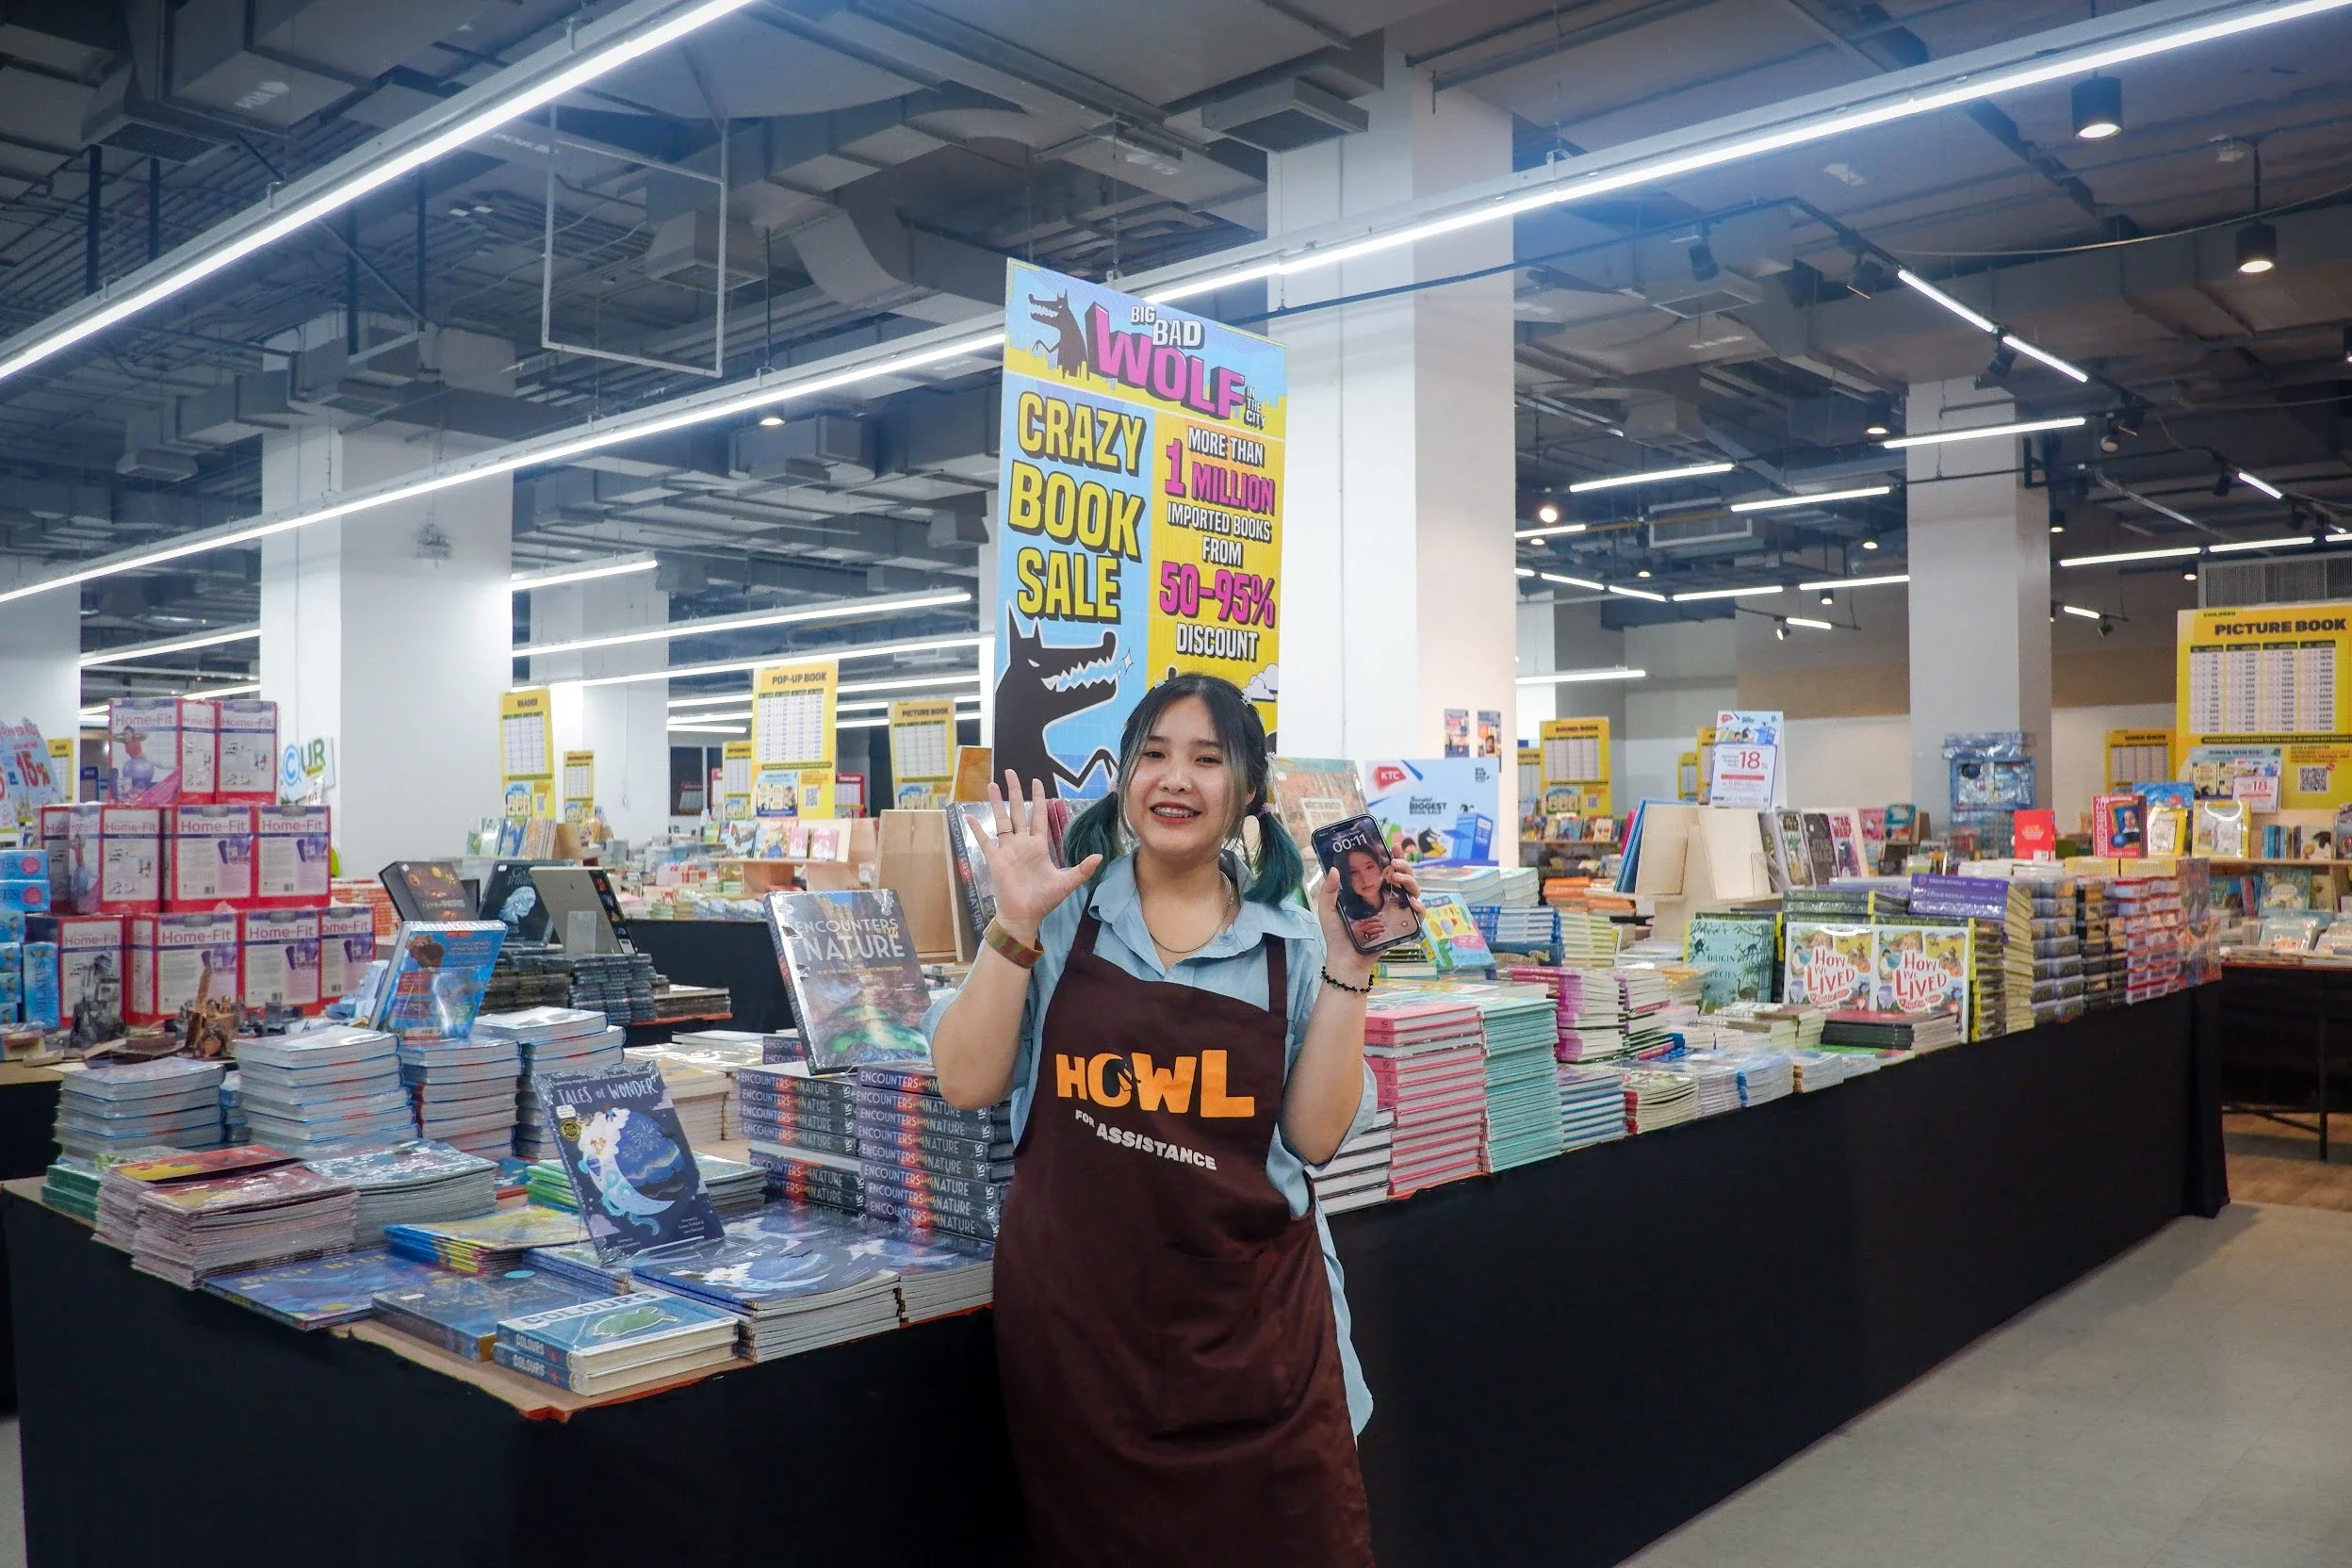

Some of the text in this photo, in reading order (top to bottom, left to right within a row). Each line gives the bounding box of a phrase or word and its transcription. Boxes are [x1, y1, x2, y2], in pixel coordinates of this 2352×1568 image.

[1131, 305, 1156, 325] BIG
[1153, 318, 1204, 350] BAD
[1086, 302, 1246, 420] WOLF
[1246, 384, 1255, 398] IN
[1246, 397, 1262, 413] THE
[1245, 409, 1267, 428] CITY
[1018, 390, 1148, 475] CRAZY
[1187, 426, 1265, 466] MORE THAN
[1165, 438, 1275, 516] 1 MILLION
[1007, 462, 1146, 562] BOOK
[1167, 501, 1272, 543] IMPORTED BOOKS
[1202, 537, 1243, 566] FROM
[1017, 547, 1121, 623] SALE
[1159, 561, 1275, 627] 50-95%
[2214, 618, 2346, 636] PICTURE BOOK
[1176, 623, 1259, 662] DISCOUNT
[773, 672, 826, 685] POP-UP BOOK
[115, 714, 172, 727] Home-Fit
[220, 717, 272, 728] Home-Fit
[903, 709, 930, 717] PICTURE
[1380, 771, 1401, 781] KTC
[1410, 802, 1446, 810] BIGGEST
[106, 820, 155, 831] Home-Fit
[181, 820, 245, 832] Home-Fit
[262, 819, 322, 831] Home-Fit
[1332, 833, 1368, 853] 00:11
[948, 808, 971, 876] ENCOUNTERS
[969, 889, 985, 931] NATURE
[162, 929, 231, 943] Home-Fit
[249, 924, 314, 939] Home-Fit
[321, 920, 368, 933] ome-Fit
[797, 919, 898, 934] ENCOUNTERS
[65, 934, 118, 945] Home-Fit
[803, 934, 905, 961] NATURE
[1806, 967, 1855, 994] LIVED
[1895, 971, 1947, 1000] LIVED
[765, 1039, 803, 1049] ENCOUNTE
[557, 1086, 593, 1105] TALES
[608, 1078, 659, 1100] WONDER
[741, 1073, 789, 1088] ENCOUNTERS
[799, 1082, 829, 1096] NATURE
[860, 1070, 919, 1088] ENCOUNTERS
[1055, 1050, 1255, 1118] HOWL
[743, 1089, 791, 1105] ENCOUNTERS
[801, 1097, 830, 1113] NATURE
[856, 1090, 913, 1109] ENCOUNTERS
[925, 1101, 961, 1118] NATURE
[743, 1105, 791, 1120] ENCOUNTERS
[801, 1116, 831, 1131] NATURE
[860, 1108, 917, 1126] ENCOUNTERS
[929, 1118, 966, 1136] NATURE
[743, 1122, 792, 1139] ENCOUNTERS
[801, 1133, 831, 1149] NATURE
[858, 1125, 913, 1144] ENCOUNTERS
[924, 1135, 959, 1154] NATURE
[1075, 1109, 1217, 1170] FOR ASSISTANCE
[862, 1143, 916, 1164] ENCOUNTERS
[927, 1153, 962, 1174] NATURE
[811, 1168, 842, 1187] NATURE
[864, 1164, 921, 1185] ENCOUNTERS
[933, 1176, 970, 1197] NATURE
[811, 1185, 841, 1204] NATURE
[868, 1182, 923, 1204] ENCOUNTERS
[936, 1196, 971, 1216] NATURE
[870, 1200, 927, 1222] ENCOUNTERS
[939, 1215, 976, 1234] NATURE
[520, 1292, 658, 1325] COLOURS
[515, 1333, 546, 1356] COLOURS
[513, 1352, 545, 1377] COLOURS
